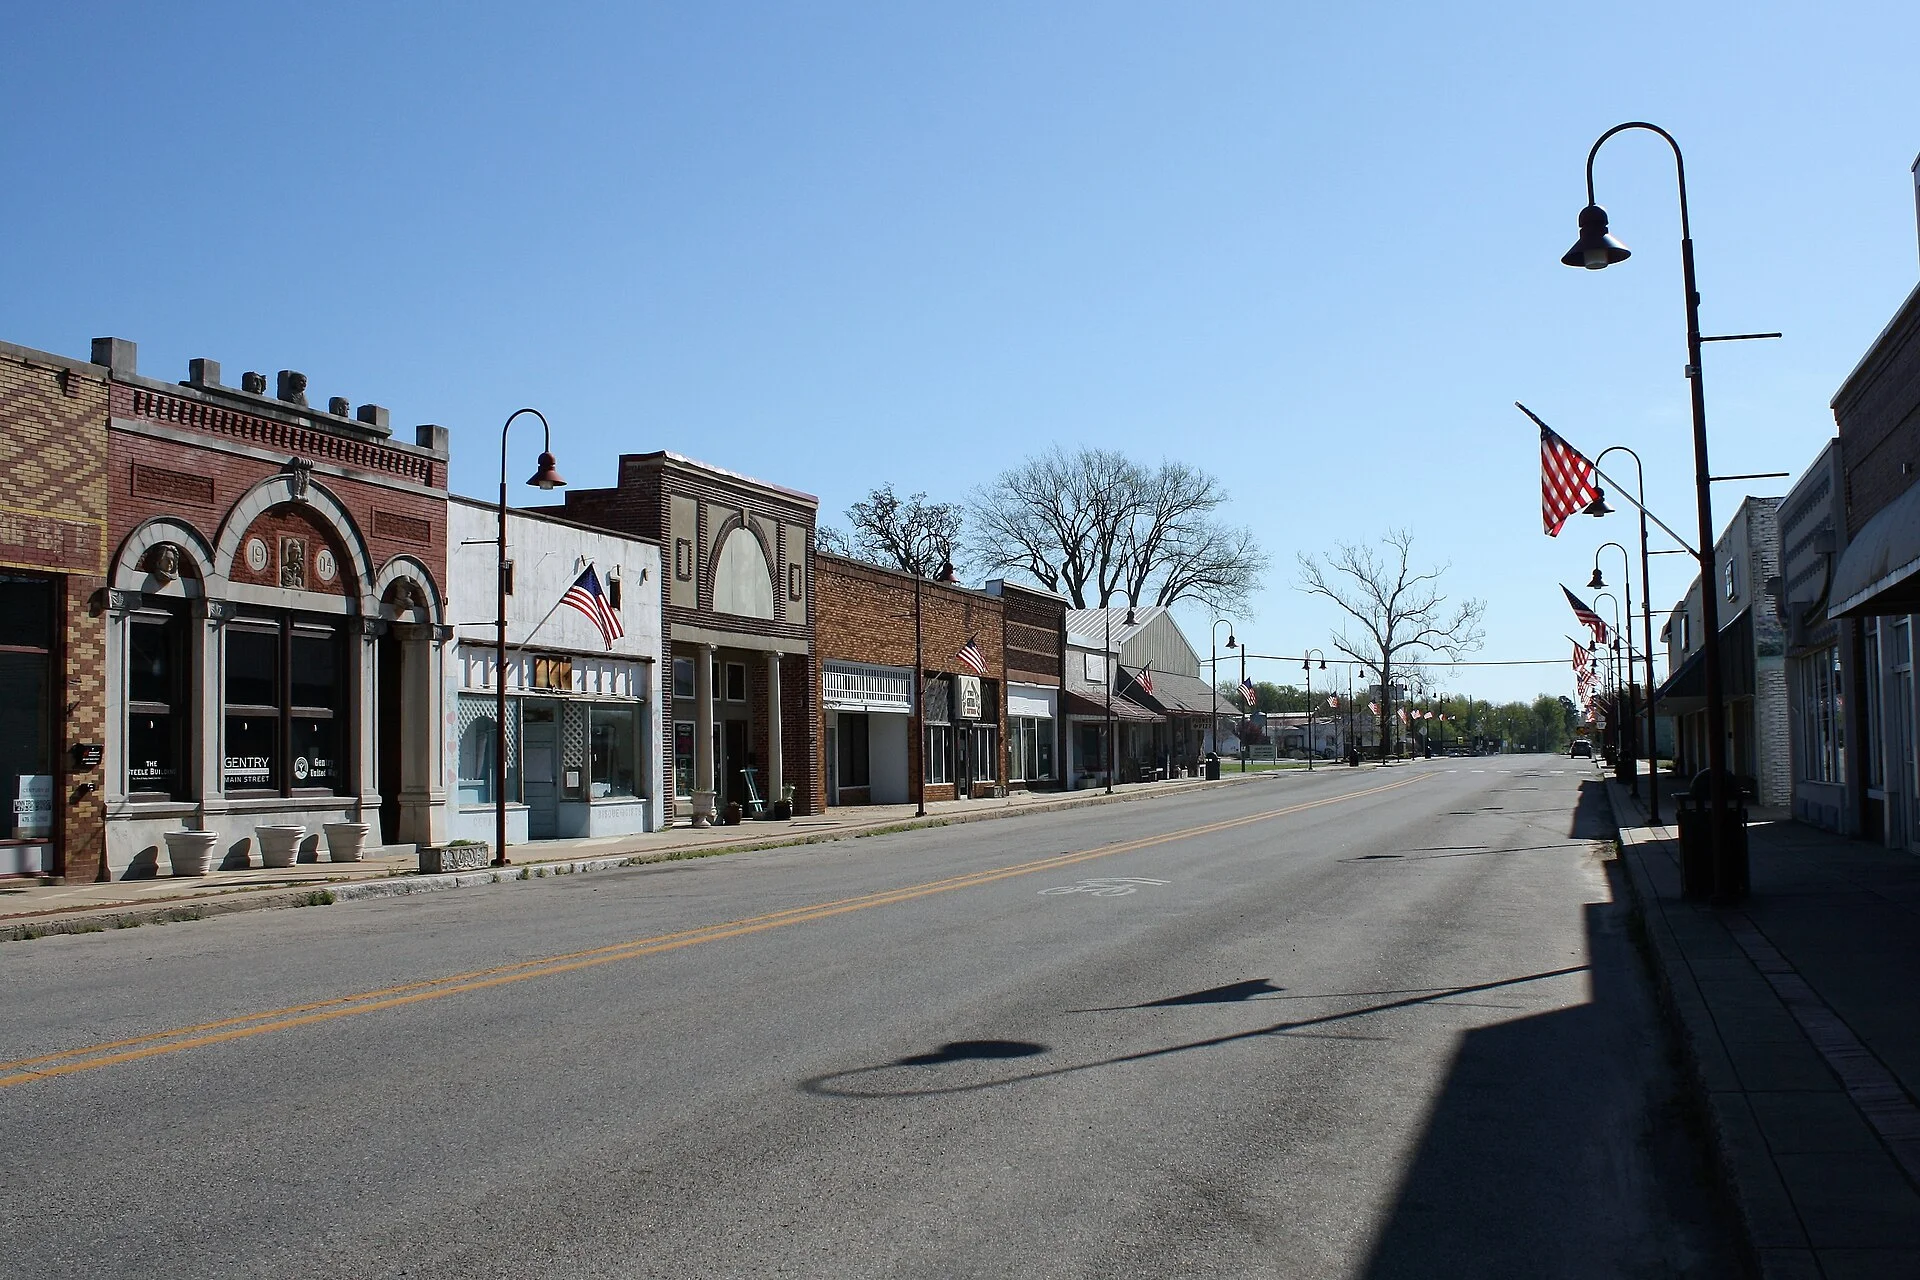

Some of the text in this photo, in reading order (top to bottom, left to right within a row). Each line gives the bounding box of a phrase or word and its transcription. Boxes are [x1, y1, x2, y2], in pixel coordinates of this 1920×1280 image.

[252, 545, 264, 563] 19
[319, 556, 333, 574] 04
[224, 756, 270, 768] GENTRY
[243, 775, 270, 783] STREET
